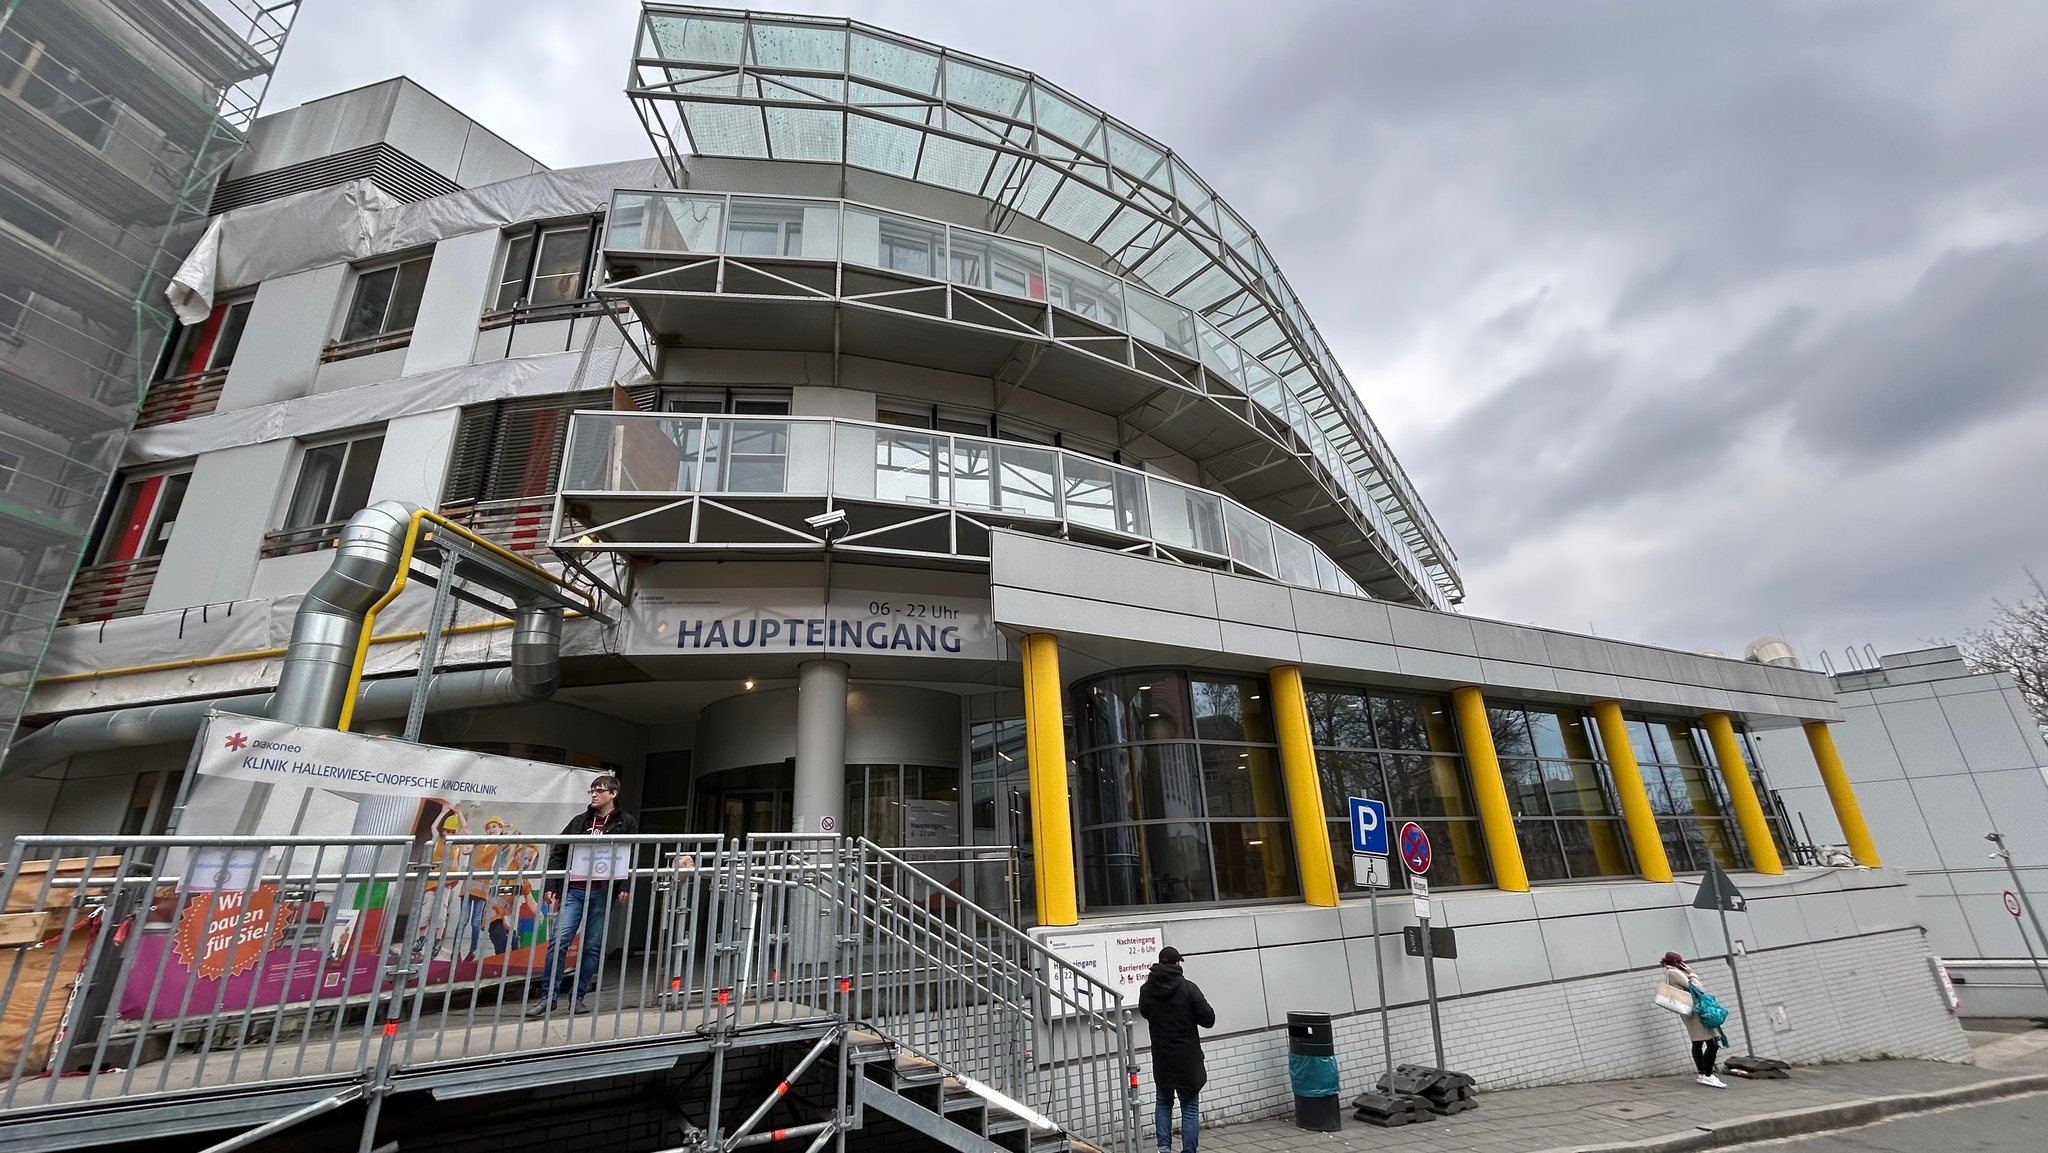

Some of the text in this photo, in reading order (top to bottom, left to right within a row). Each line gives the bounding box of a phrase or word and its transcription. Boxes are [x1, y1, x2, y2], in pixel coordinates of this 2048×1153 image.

[868, 601, 891, 616] 06
[906, 603, 926, 618] 22
[931, 604, 960, 620] Uhr
[676, 618, 961, 653] HAUPTEINGANG
[242, 755, 497, 796] KLINIK HALLERWIESE-CNOPFSCHE KINDERKLINIK
[1358, 805, 1378, 845] P
[218, 892, 244, 912] Wi
[202, 922, 269, 960] für Sie!
[1116, 937, 1156, 946] Nachteingang
[1128, 947, 1137, 955] 22
[1141, 946, 1146, 954] 6
[1146, 945, 1157, 953] Uhr
[1054, 971, 1073, 981] 6 22
